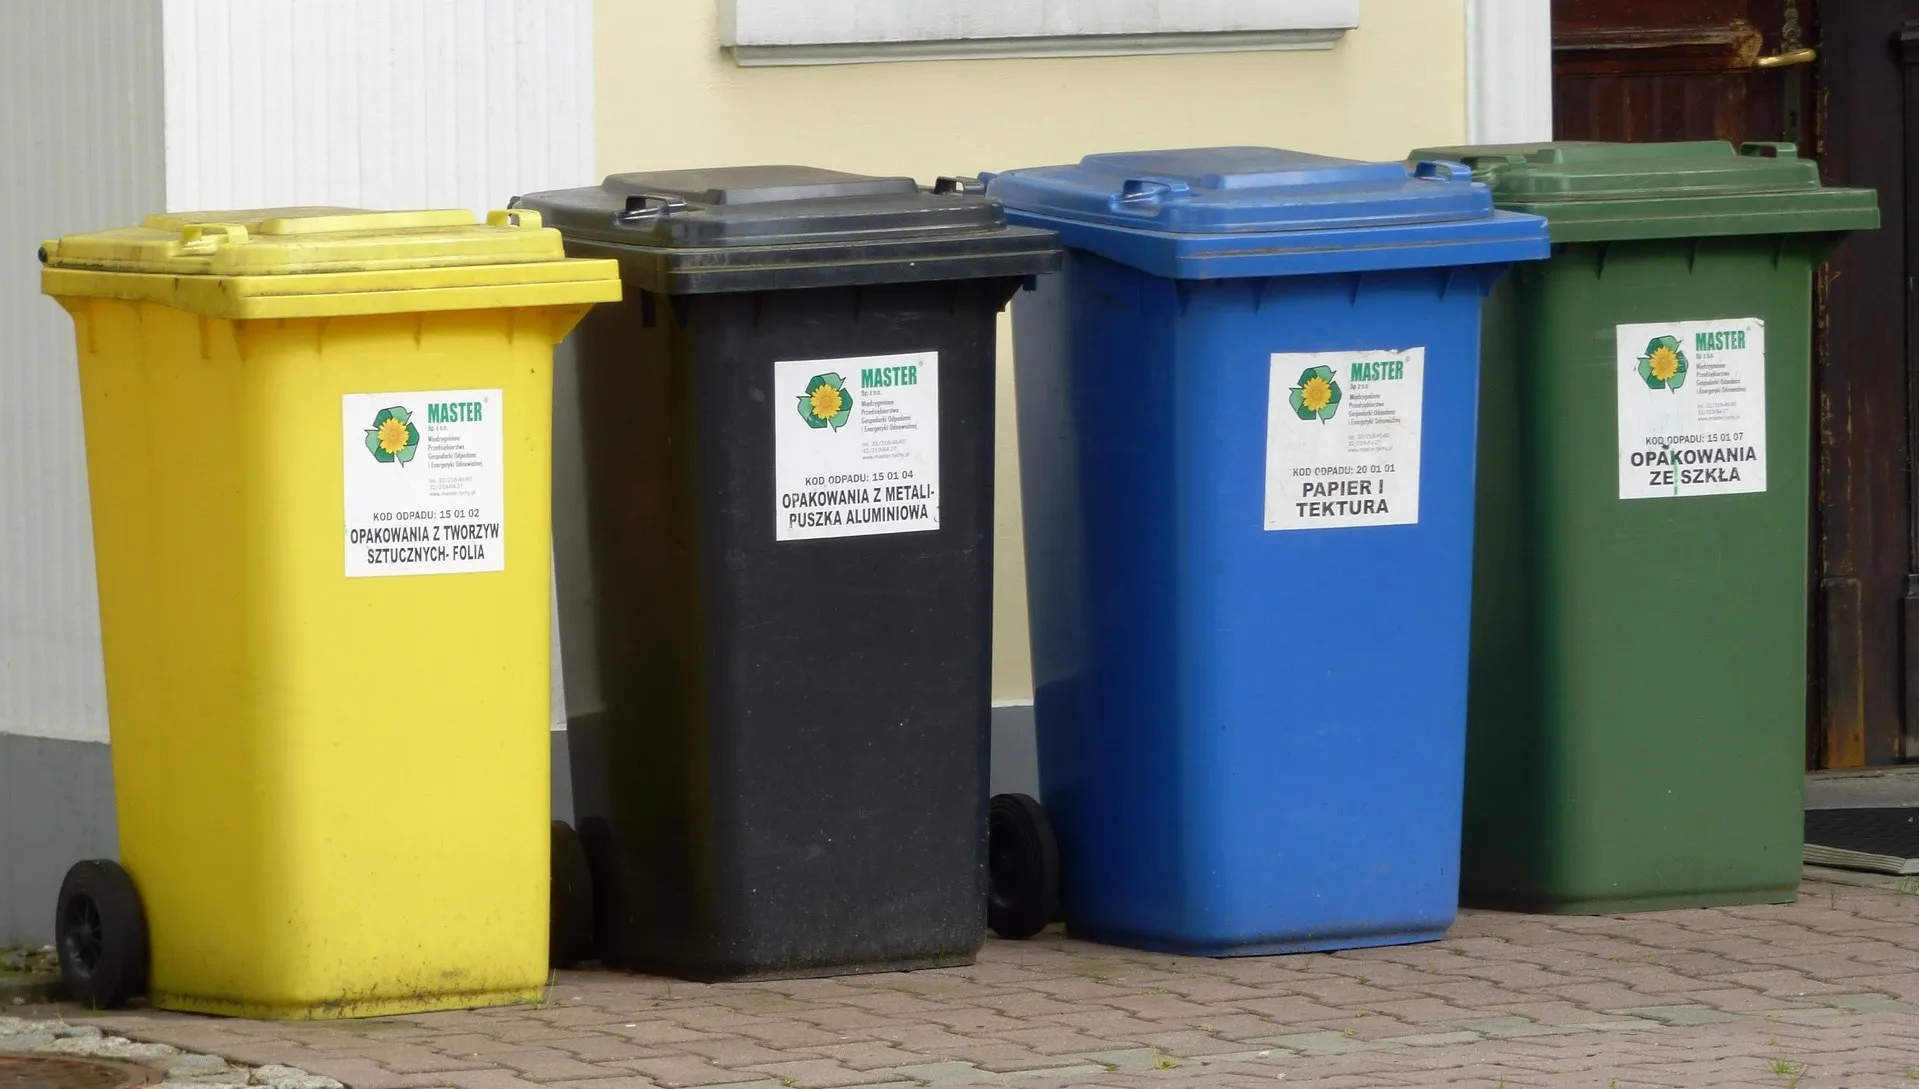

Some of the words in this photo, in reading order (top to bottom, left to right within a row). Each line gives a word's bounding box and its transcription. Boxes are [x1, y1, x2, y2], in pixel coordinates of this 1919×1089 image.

[1696, 330, 1746, 351] MASTER
[861, 365, 917, 388] MASTER
[1350, 360, 1404, 382] MASTER
[428, 402, 482, 423] MASTER
[1645, 436, 1664, 445] KOD
[1667, 434, 1705, 445] ODPADU:
[1707, 434, 1718, 443] 15
[1720, 433, 1731, 442] 01
[1733, 432, 1744, 441] 07
[1630, 446, 1757, 467] OPAKOWANIA
[805, 477, 825, 486] KOD
[828, 473, 869, 485] ODPADU:
[872, 472, 884, 481] 15
[887, 471, 899, 480] 01
[902, 470, 914, 479] 04
[1293, 467, 1312, 477] KOD
[1314, 466, 1353, 476] ODPADU:
[1356, 465, 1368, 474] 20
[1370, 464, 1381, 474] 01
[1384, 464, 1396, 473] 01
[1650, 470, 1674, 486] ZE
[1681, 467, 1741, 484] SZKŁA
[782, 488, 870, 509] OPAKOWANIA
[873, 487, 882, 503] Z
[885, 484, 935, 502] METALI-
[1302, 480, 1372, 498] PAPIER
[1379, 479, 1384, 494] I
[373, 512, 392, 521] KOD
[396, 510, 437, 520] ODPADU:
[439, 510, 451, 519] 15
[454, 509, 466, 518] 01
[468, 508, 480, 518] 02
[789, 510, 842, 528] PUSZKA
[846, 504, 928, 524] ALUMINIOWA
[1296, 499, 1389, 517] TEKTURA
[350, 526, 429, 544] OPAKOWANIA
[433, 526, 440, 541] Z
[443, 523, 500, 540] TWORZYW
[367, 546, 449, 564] SZTUCZNYCH-
[453, 544, 485, 561] FOLIA
